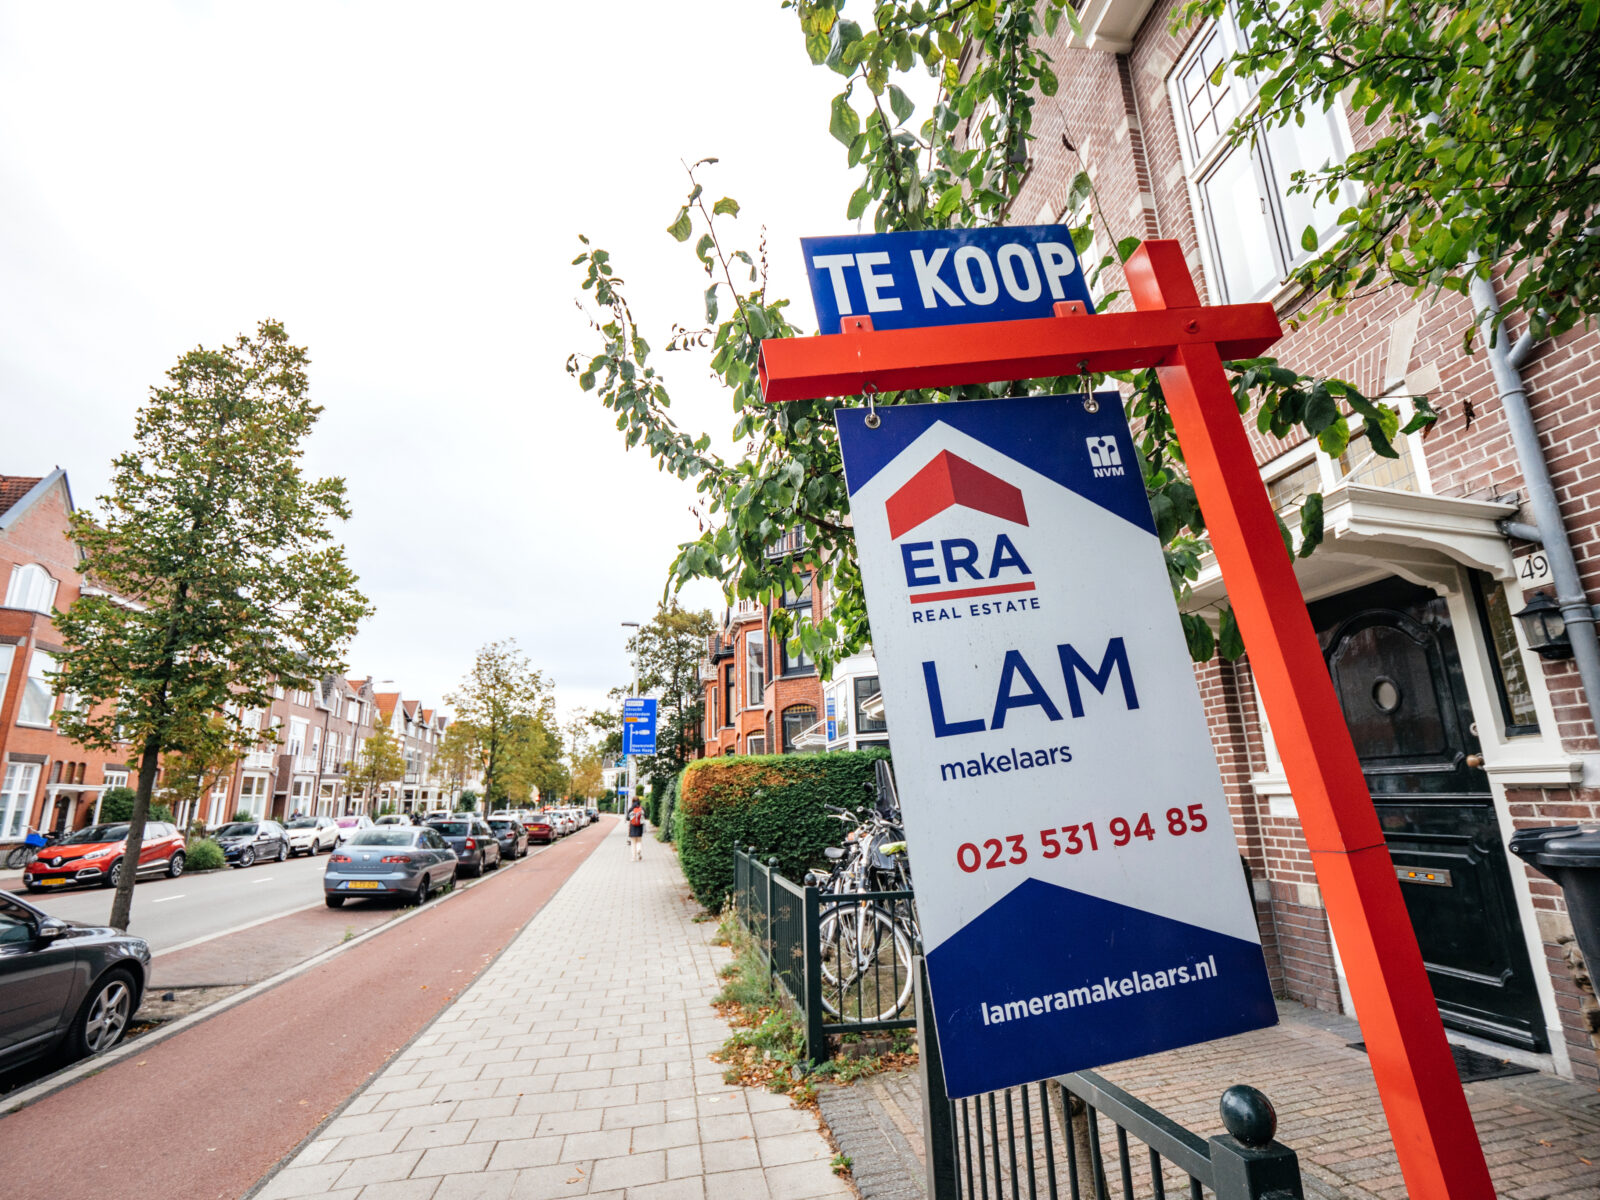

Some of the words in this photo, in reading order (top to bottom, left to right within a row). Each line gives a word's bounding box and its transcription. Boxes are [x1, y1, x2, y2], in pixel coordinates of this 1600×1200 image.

[812, 252, 903, 315] TE
[911, 242, 1076, 309] KOOP
[1093, 464, 1125, 478] NVM
[900, 533, 1033, 588] ERA
[1520, 555, 1549, 580] 49
[912, 607, 962, 624] REAL
[969, 597, 1041, 617] ESTATE
[921, 636, 1140, 739] LAM
[940, 745, 1073, 782] makelaars
[956, 834, 1028, 873] 023
[1040, 822, 1099, 859] 531
[1109, 813, 1155, 847] 94
[1166, 803, 1207, 837] 85
[981, 955, 1218, 1026] lameramakelaars.nl
